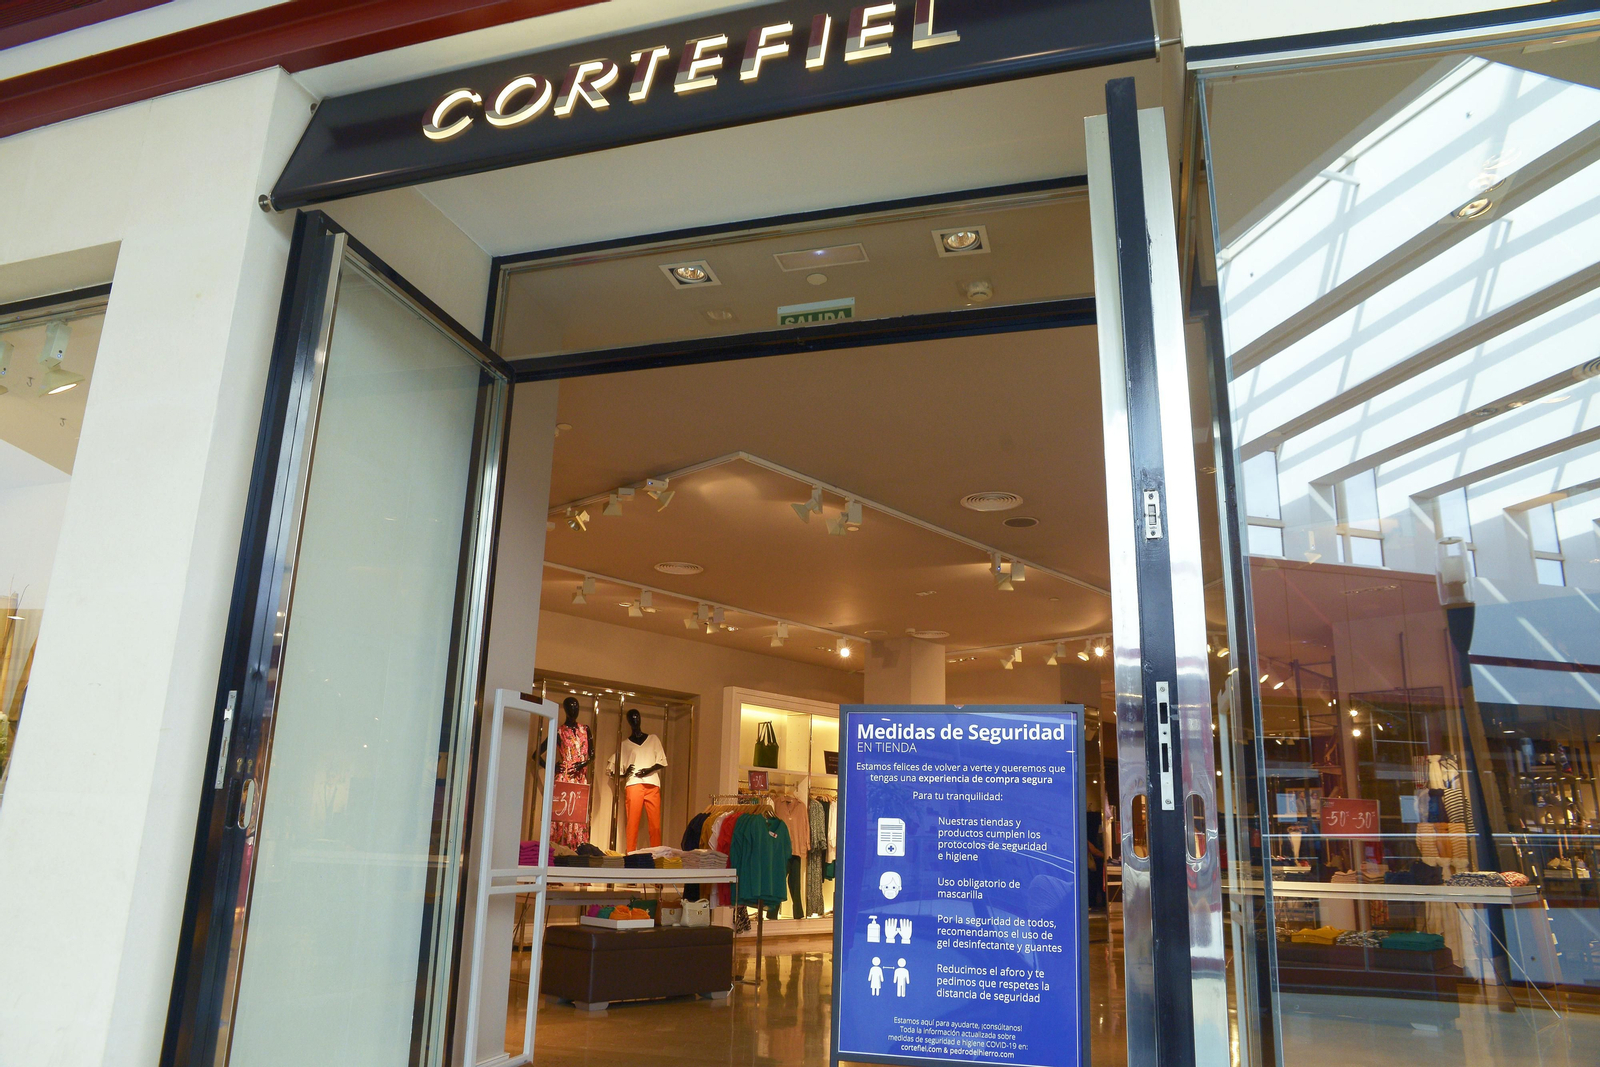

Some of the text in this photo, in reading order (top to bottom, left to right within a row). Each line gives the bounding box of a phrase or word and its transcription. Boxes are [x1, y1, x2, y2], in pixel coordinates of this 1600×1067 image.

[422, 0, 961, 141] CORTEFIEL
[858, 723, 1065, 745] Medidas de Seguridad
[857, 742, 917, 753] EN TIENDA
[856, 762, 891, 771] Estamos
[893, 762, 920, 771] felices
[921, 763, 933, 771] de
[934, 763, 961, 772] volver
[970, 764, 992, 772] verte
[994, 765, 1000, 774] y
[1001, 765, 1046, 774] queremos
[1048, 766, 1066, 775] que
[870, 774, 898, 784] tengas
[918, 774, 970, 784] experiencia
[971, 774, 983, 783] de
[985, 776, 1020, 785] compra
[1022, 777, 1053, 786] segura
[913, 791, 1003, 803] Para tu tranquilidad:
[938, 816, 1021, 829] Nuestras tiendas y
[938, 828, 1041, 840] productos cumplen los
[938, 840, 1047, 852] protocolos de seguridad
[945, 851, 978, 863] higiene
[938, 877, 1020, 890] Uso obligatorio de
[938, 890, 983, 899] mascarilla
[937, 914, 1057, 929] Por la seguridad de todos,
[937, 928, 1009, 938] recomendamos
[1011, 929, 1019, 938] el
[1041, 930, 1053, 940] de
[936, 938, 1062, 954] gel desinfectante y guantes
[937, 963, 1045, 980] Reducimos el aforo y te
[936, 976, 1050, 992] pedimos que respetes la
[936, 988, 1040, 1004] distancia de seguridad
[894, 1016, 920, 1025] Estamos
[920, 1019, 934, 1027] aquí
[951, 1021, 980, 1029] ayudarte,
[923, 1027, 960, 1036] información
[961, 1031, 996, 1039] actualizada
[997, 1033, 1016, 1041] sobre
[901, 1044, 942, 1053] cortefiel.com
[950, 1048, 1014, 1058] pedrodelhierro.com
[962, 1040, 985, 1048] higiene
[986, 1041, 1017, 1050] COVID-19
